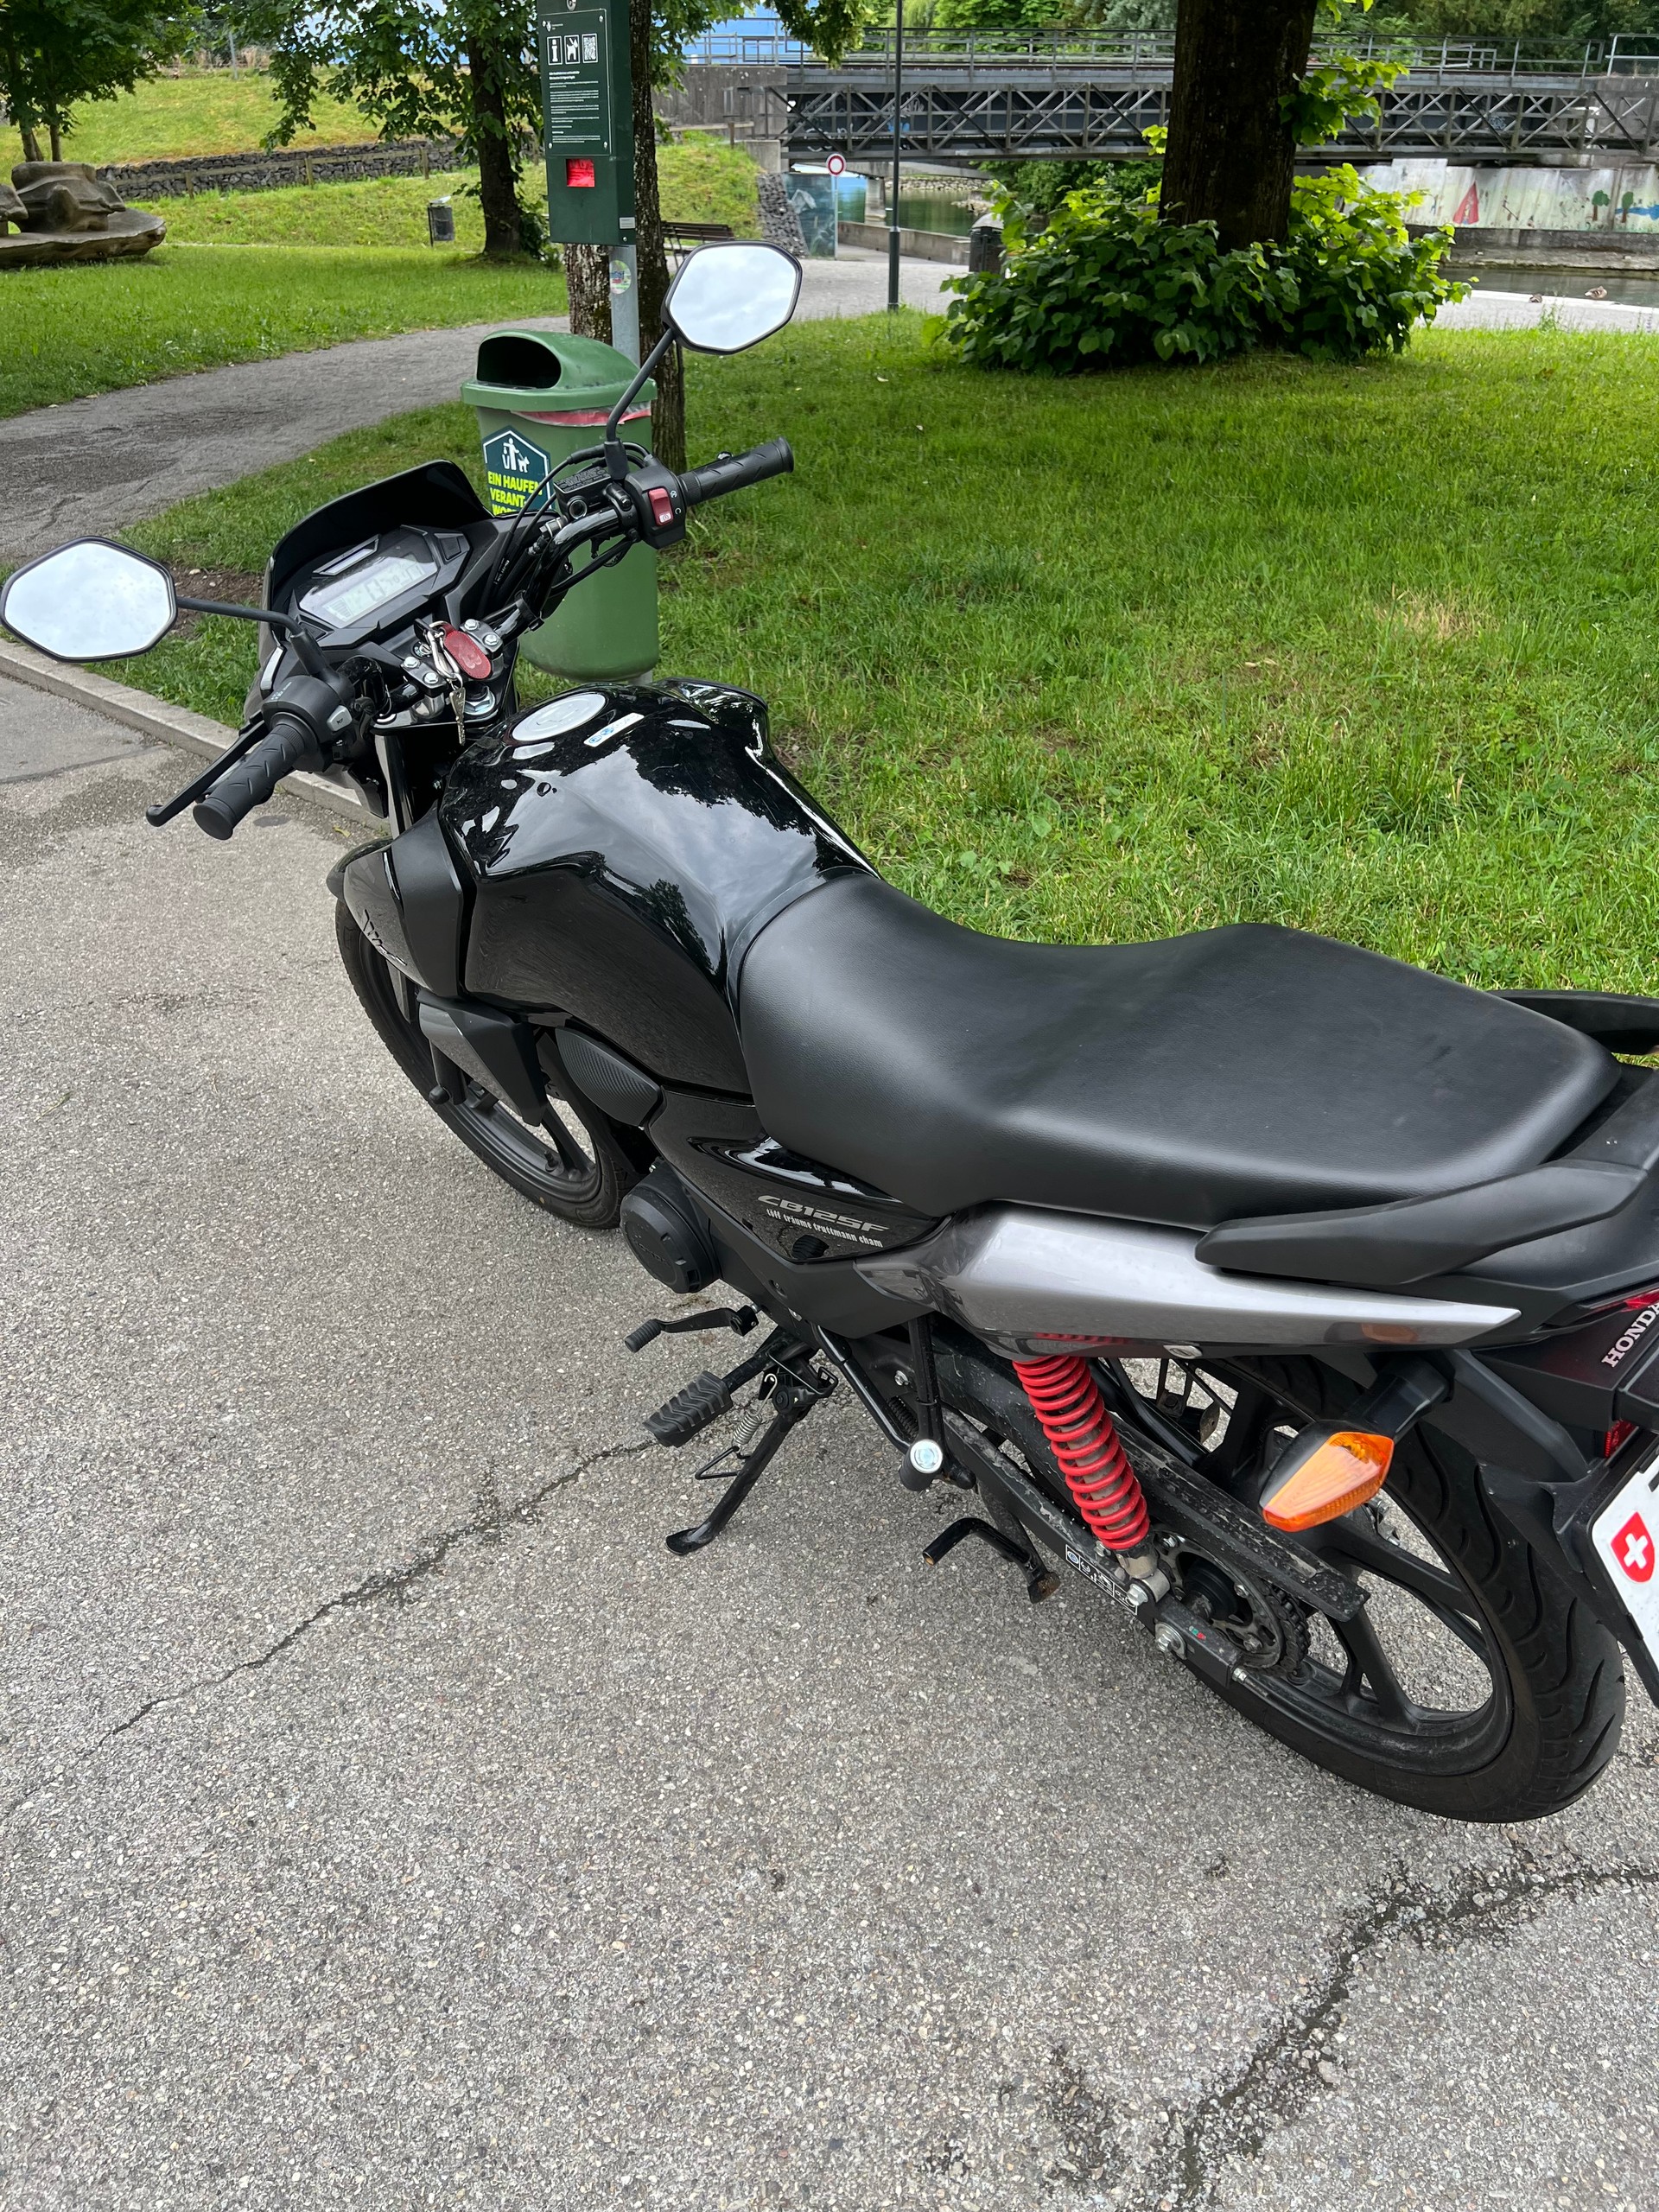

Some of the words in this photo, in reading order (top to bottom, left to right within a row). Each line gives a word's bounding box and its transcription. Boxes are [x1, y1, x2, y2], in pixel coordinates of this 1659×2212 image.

[488, 471, 502, 486] EIN
[758, 1195, 889, 1232] CB125F
[812, 1223, 858, 1243] truttmann
[858, 1235, 883, 1248] cham
